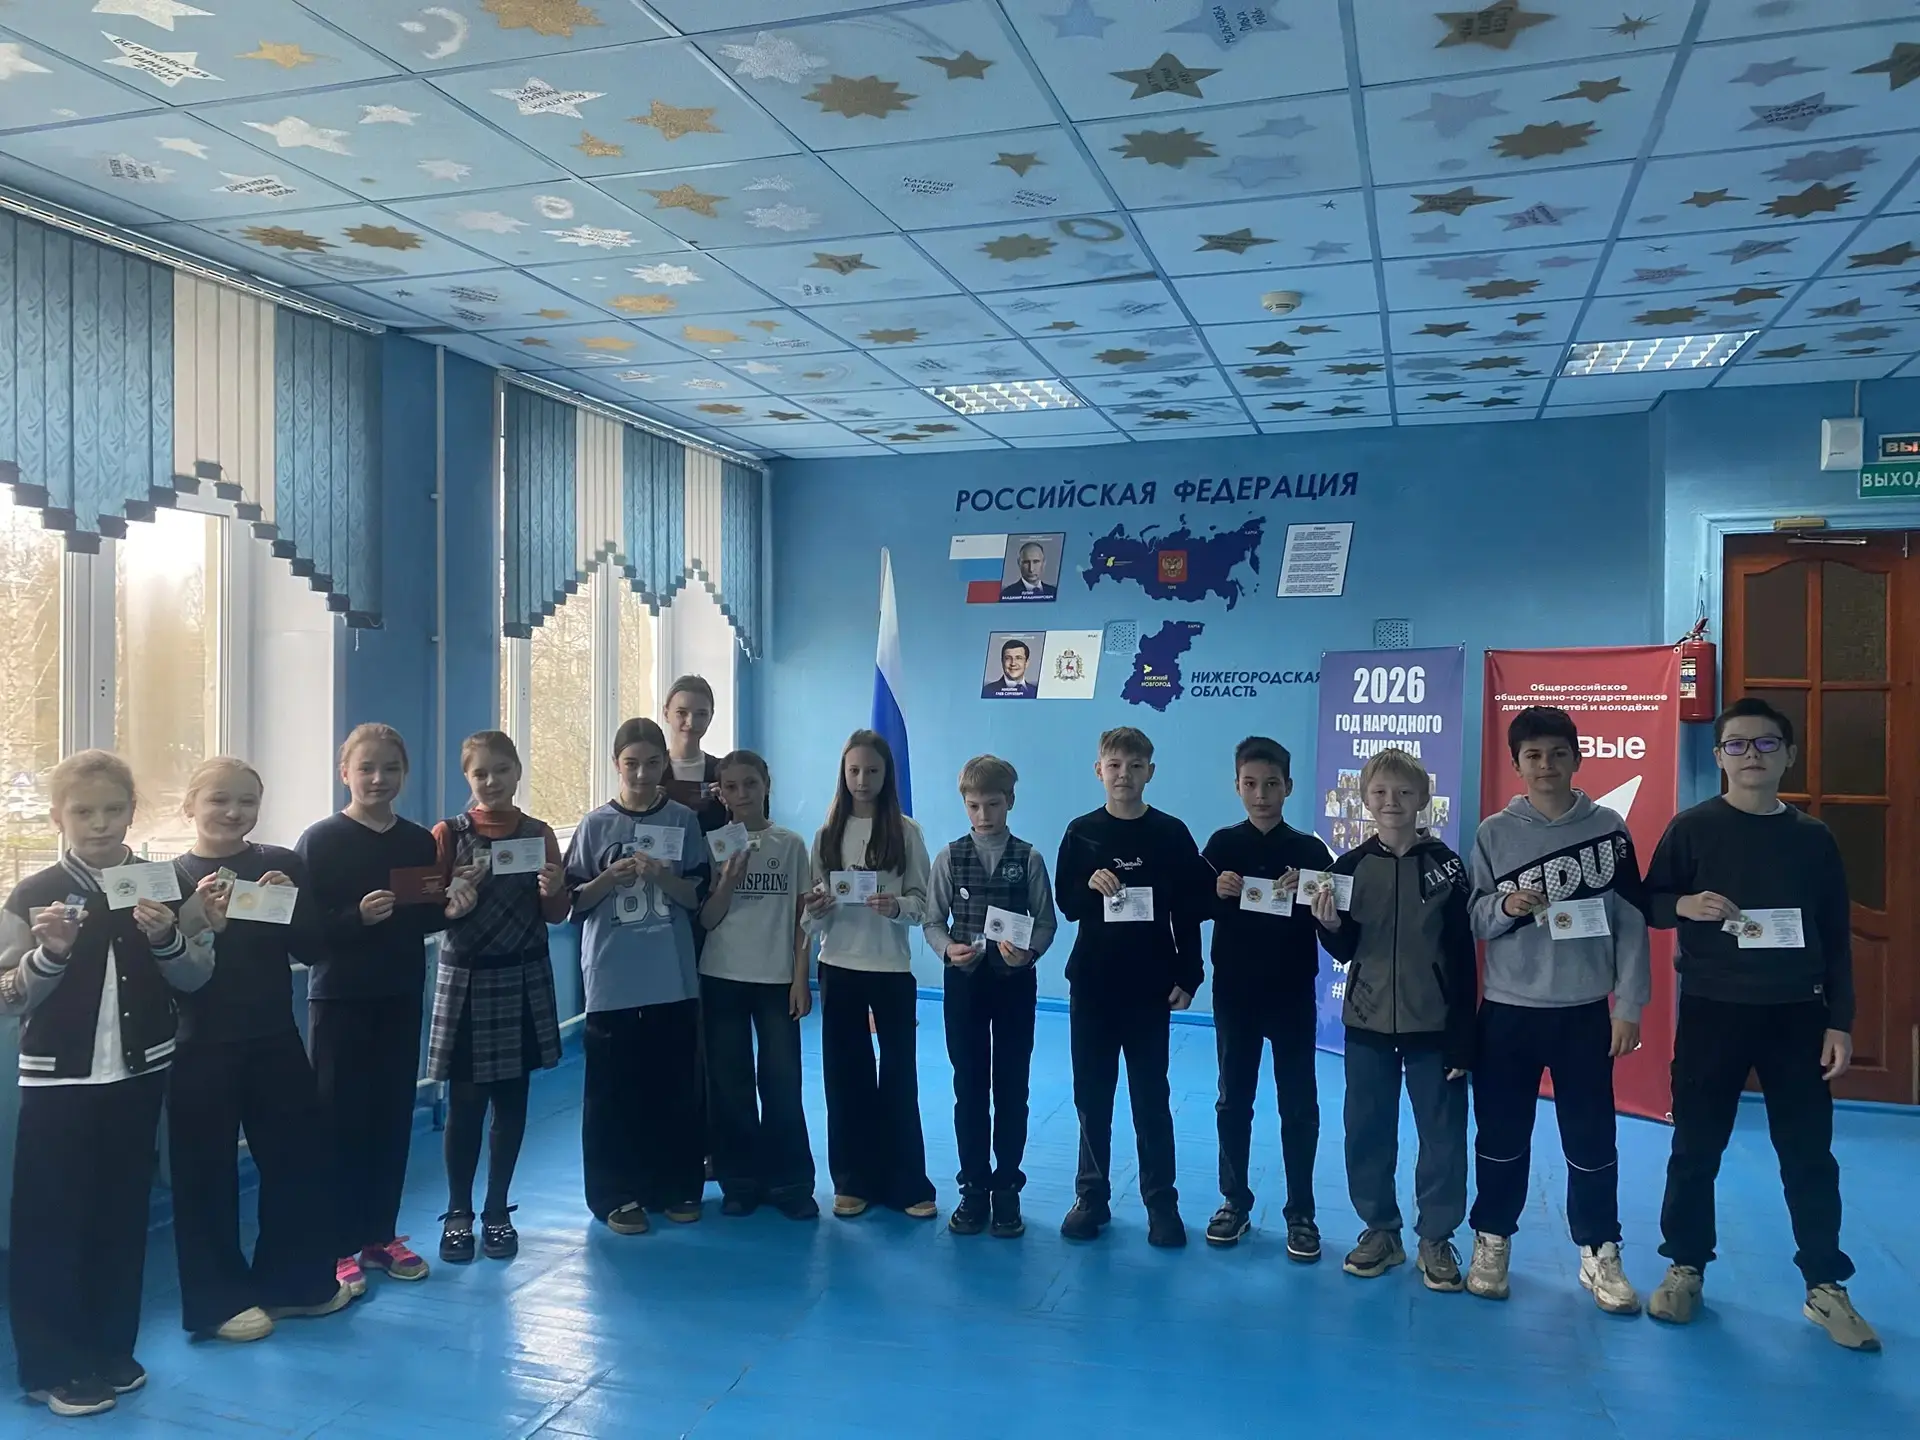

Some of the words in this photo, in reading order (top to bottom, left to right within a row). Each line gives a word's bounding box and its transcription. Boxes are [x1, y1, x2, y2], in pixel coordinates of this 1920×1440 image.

[1885, 441, 1920, 453] ВЫ
[955, 479, 1157, 512] РОССИЙСКАЯ
[1173, 472, 1359, 505] ФЕДЕРАЦИЯ
[1144, 674, 1169, 682] НИЖНИЙ
[1191, 671, 1320, 685] НИЖЕГОРОДСКАЯ
[1353, 666, 1426, 704] 2026
[1530, 683, 1629, 693] Общероссийское
[1190, 685, 1258, 698] ОБЛАСТЬ
[1494, 693, 1669, 703] общественно-государственное
[1599, 703, 1660, 713] молодёжи
[1335, 714, 1361, 734] ГОД
[1362, 714, 1443, 736] НАРОДНОГО
